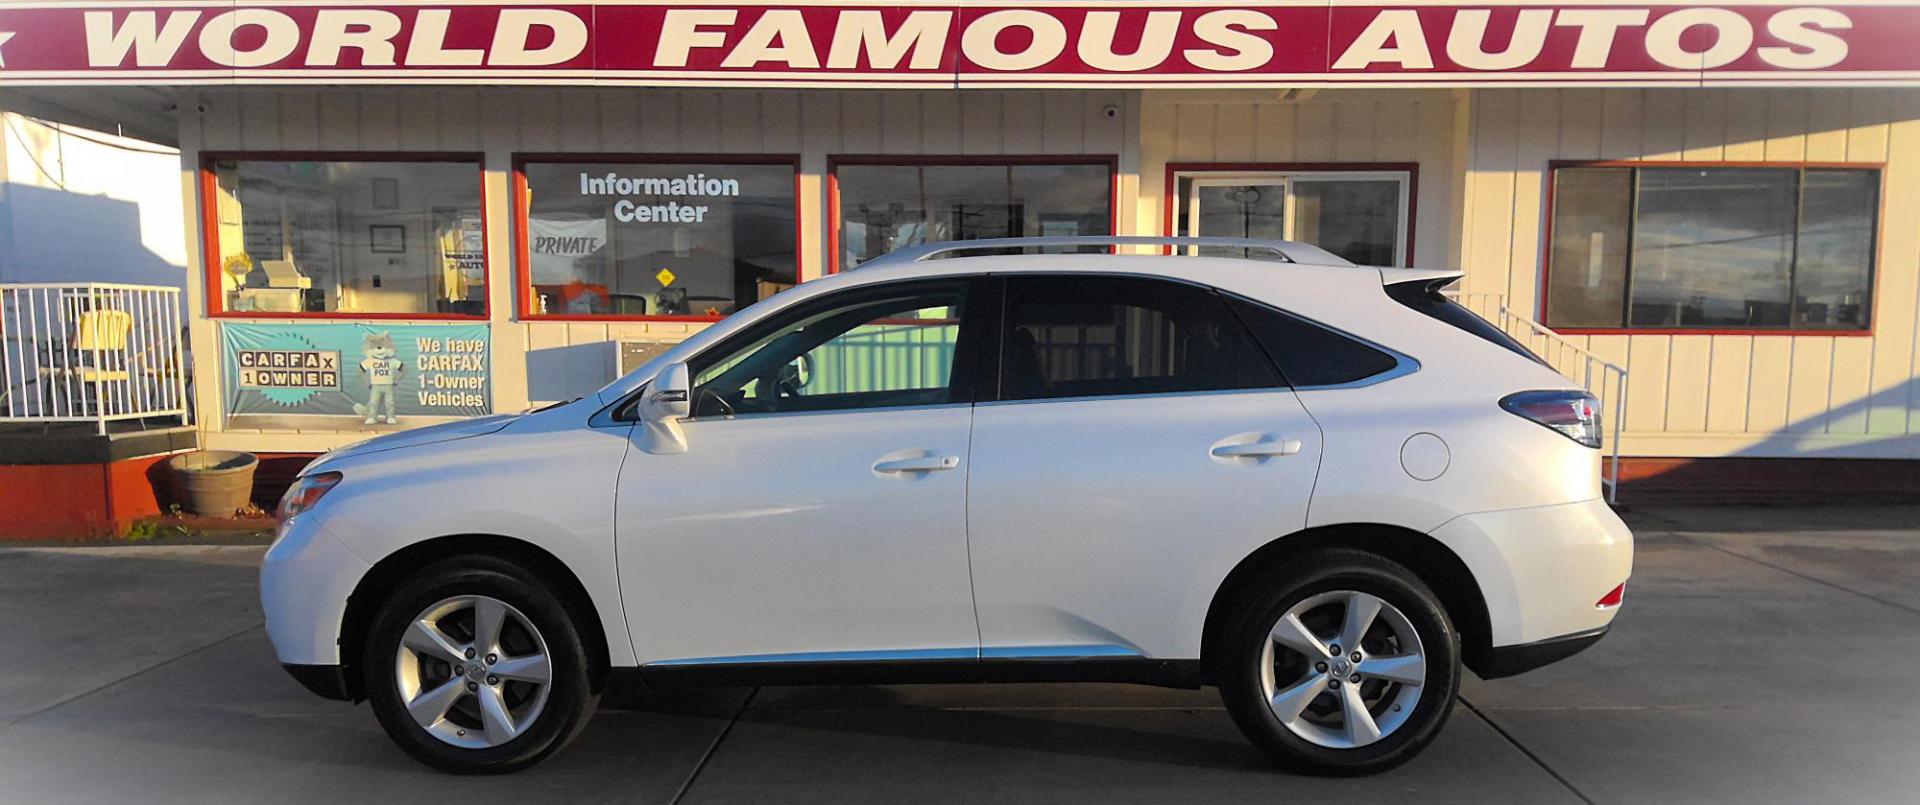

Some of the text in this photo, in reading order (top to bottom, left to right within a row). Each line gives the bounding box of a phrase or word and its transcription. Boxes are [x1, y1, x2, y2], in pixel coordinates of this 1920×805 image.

[84, 7, 1853, 71] WORLD FAMOUS AUTOS
[580, 172, 739, 196] Information
[614, 200, 708, 222] Center
[535, 236, 597, 254] PRIVATE
[416, 336, 484, 353] We have
[240, 352, 334, 369] CARFAX
[417, 354, 484, 371] CARFAX
[244, 371, 337, 386] 1 OWNER
[419, 373, 485, 390] 1-Owner
[418, 391, 484, 407] Vehicles
